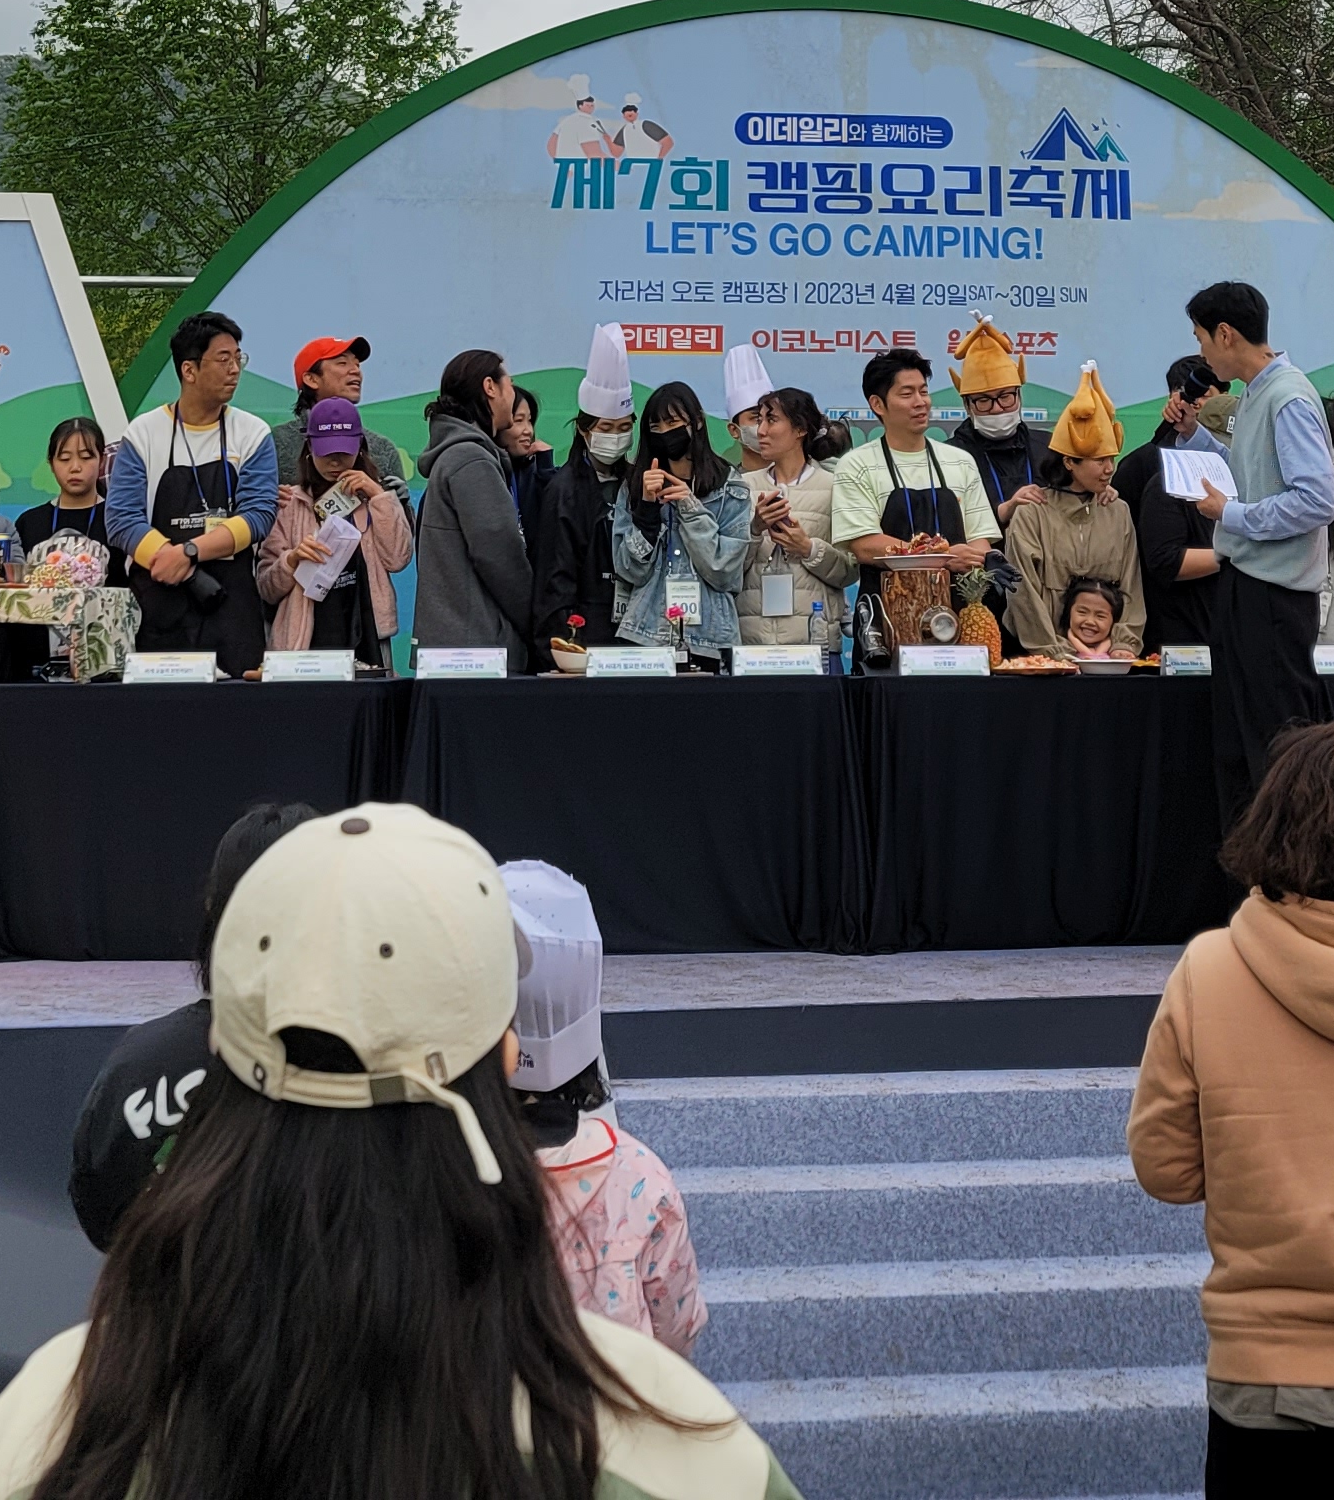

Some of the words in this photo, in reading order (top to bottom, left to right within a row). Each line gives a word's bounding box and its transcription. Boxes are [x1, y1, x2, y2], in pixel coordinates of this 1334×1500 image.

[747, 115, 867, 143] 이데일리와
[871, 123, 944, 144] 함께하는
[550, 156, 730, 212] 제7회
[746, 161, 1132, 221] 캠핑요리축제
[645, 221, 758, 255] LET'S
[769, 222, 832, 256] GO
[843, 224, 1044, 260] CAMPING!
[598, 280, 664, 303] 자라섬
[670, 280, 716, 303] 오토
[722, 281, 788, 304] 캠핑장
[804, 282, 875, 305] 2023년
[882, 283, 916, 306] 4월
[1059, 286, 1088, 304] SUN
[623, 327, 717, 350] 이데일리
[751, 329, 916, 353] 이코노미스트
[324, 499, 343, 516] 87
[616, 601, 628, 614] 10
